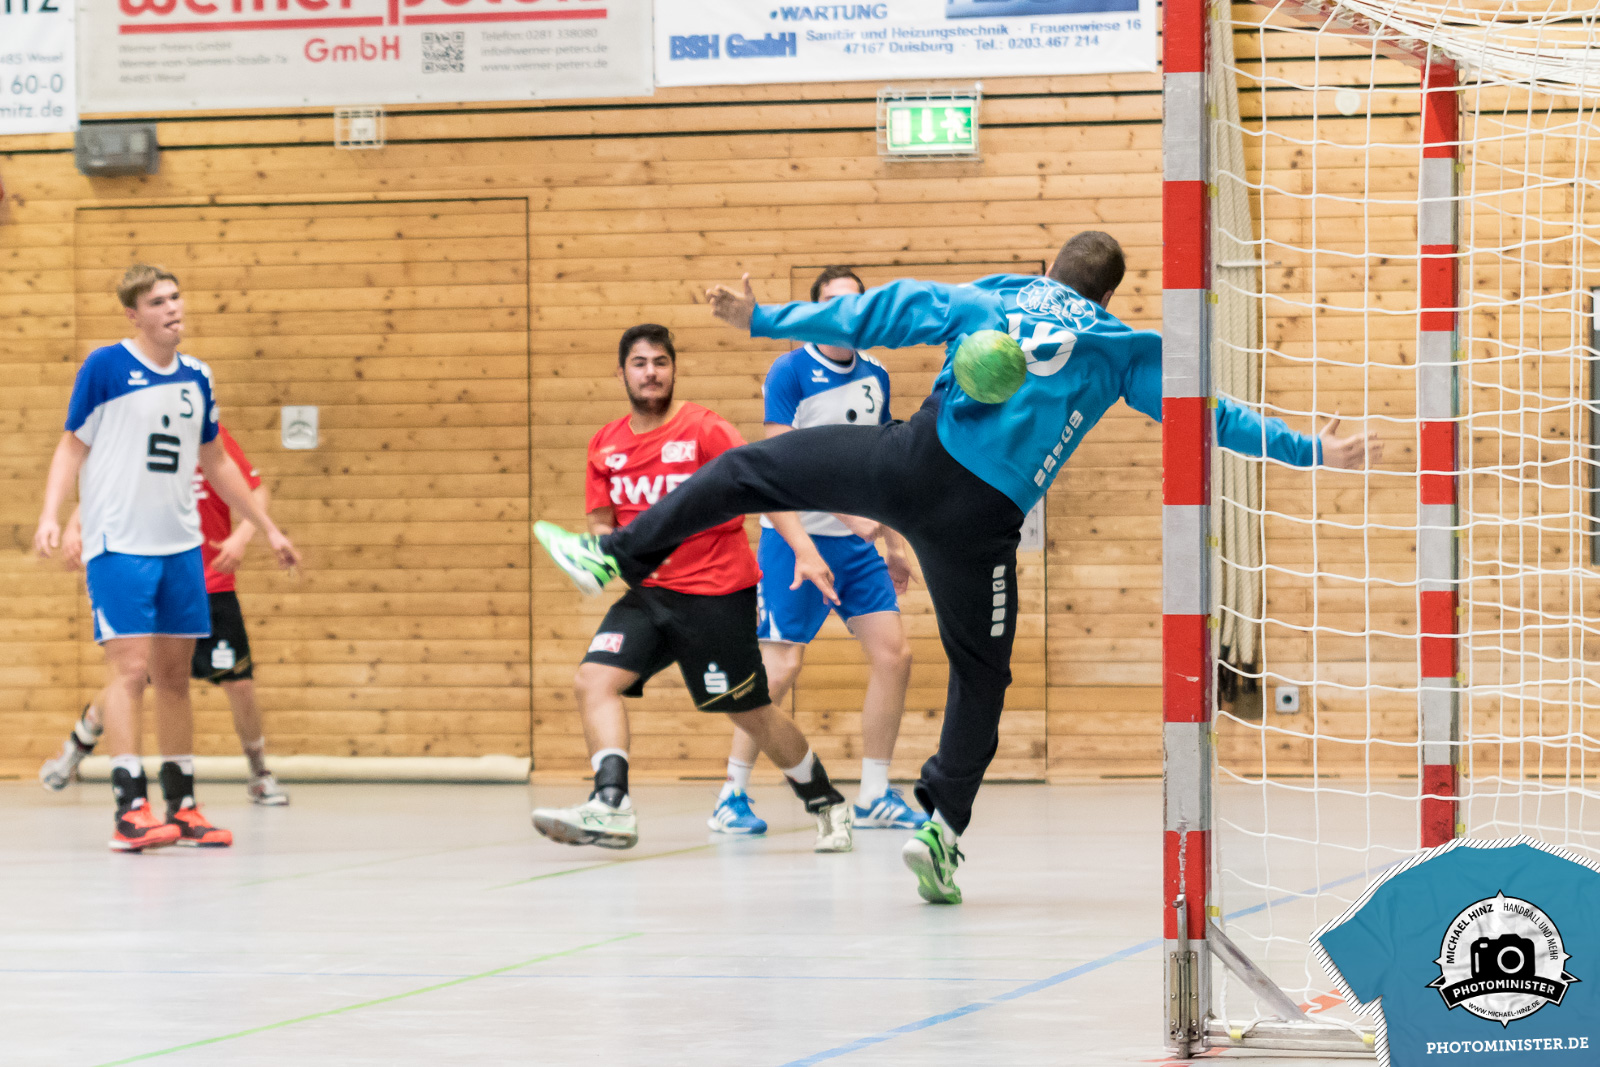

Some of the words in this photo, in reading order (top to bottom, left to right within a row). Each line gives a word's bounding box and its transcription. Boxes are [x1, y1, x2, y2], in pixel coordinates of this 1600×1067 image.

[780, 3, 888, 21] WARTUNG
[806, 29, 855, 41] Sanitär
[861, 28, 887, 39] und
[891, 25, 1009, 40] Heizungstechnik
[1030, 20, 1121, 34] Frauenwiese
[1126, 19, 1142, 31] 16
[304, 36, 400, 63] GmbH
[843, 42, 885, 54] 47167
[889, 41, 954, 54] Duisburg
[1074, 35, 1099, 47] 214
[11, 73, 63, 95] 60-0
[179, 389, 194, 418] 5
[862, 384, 875, 413] 3
